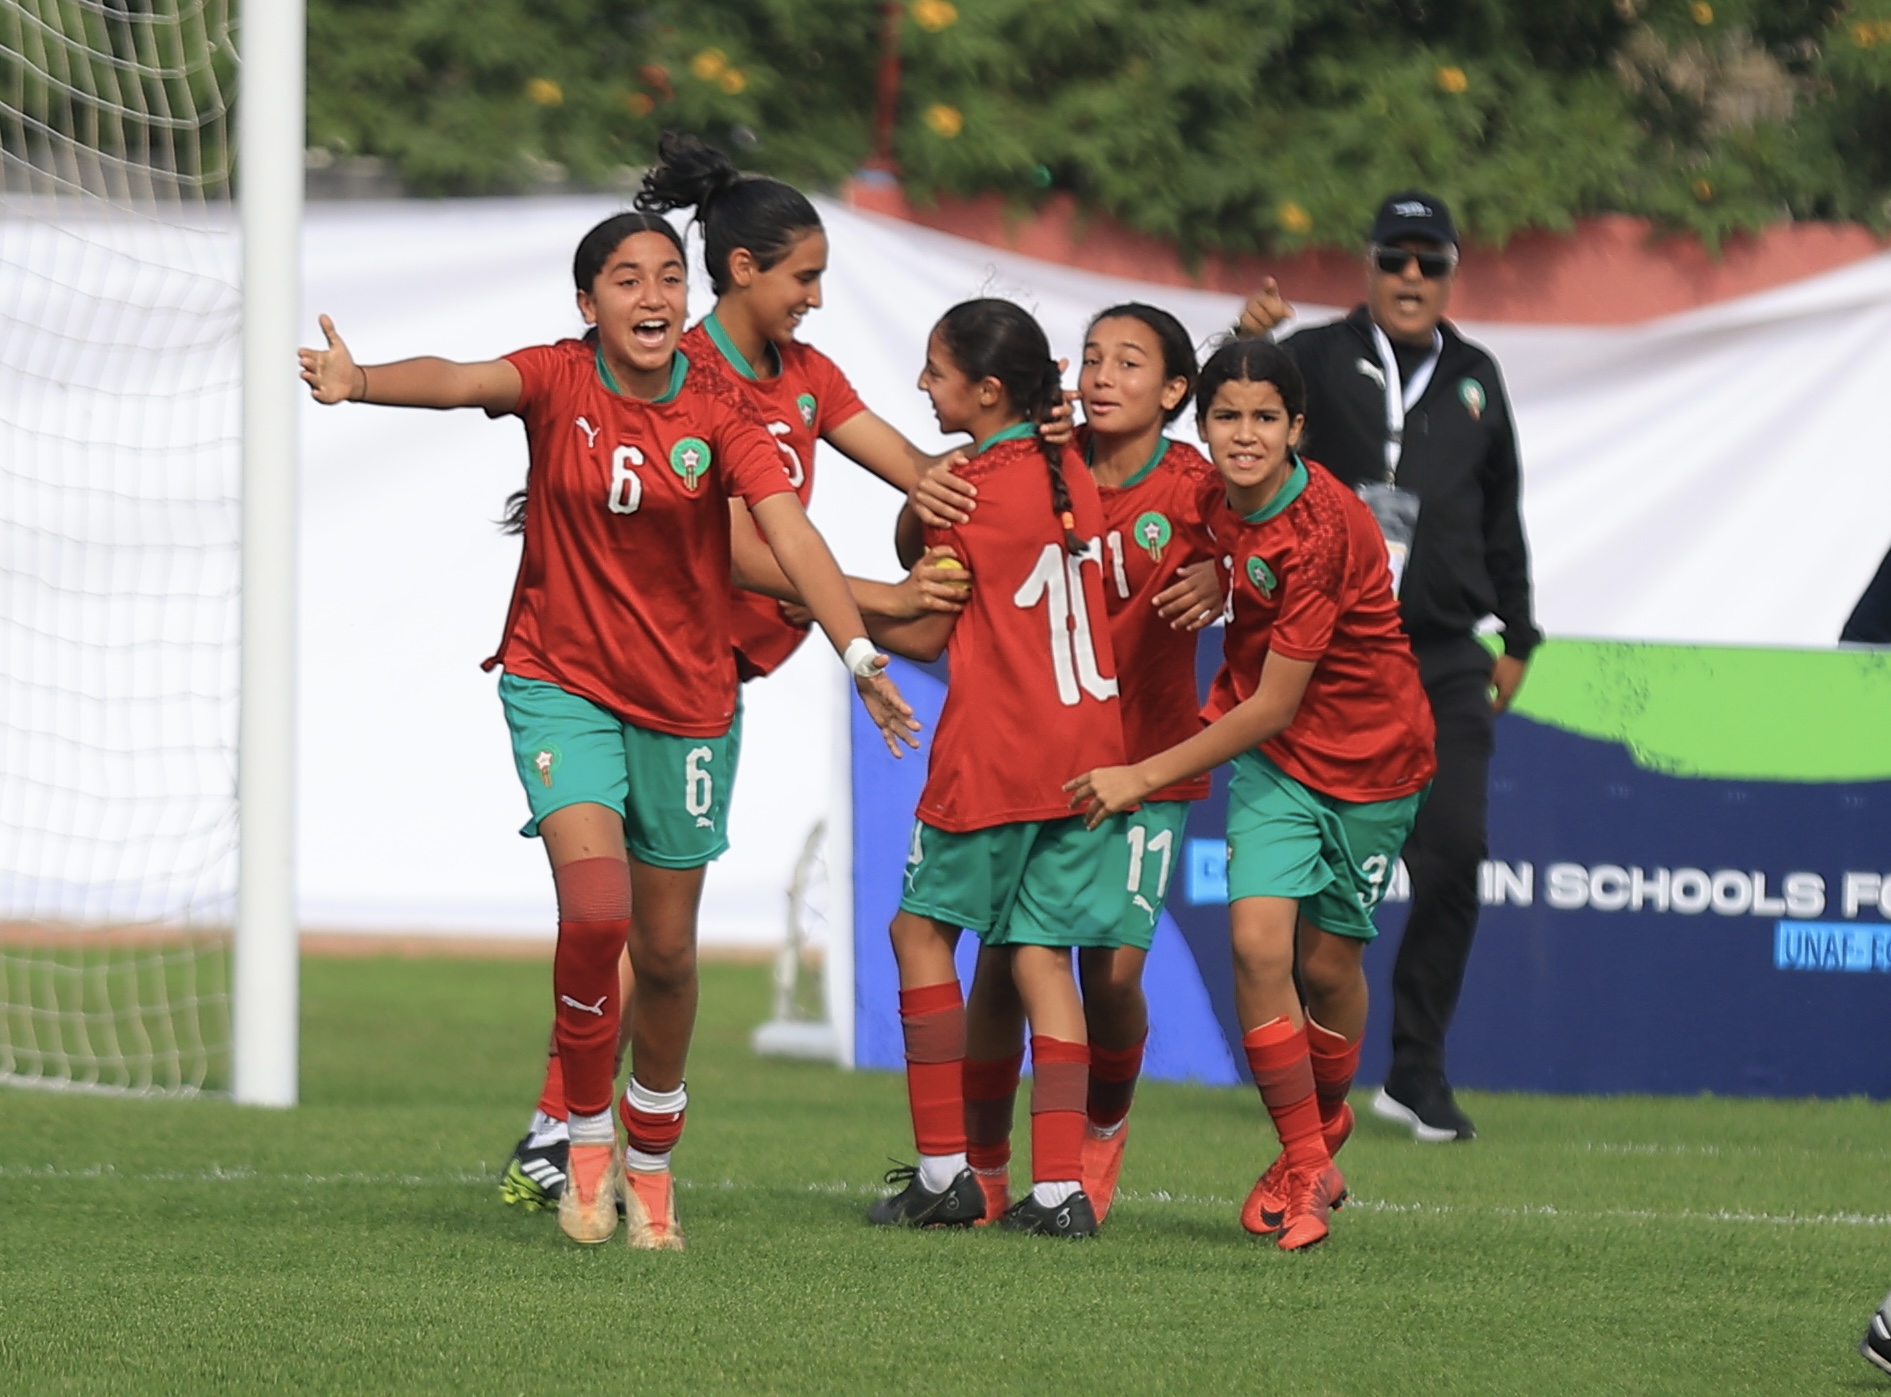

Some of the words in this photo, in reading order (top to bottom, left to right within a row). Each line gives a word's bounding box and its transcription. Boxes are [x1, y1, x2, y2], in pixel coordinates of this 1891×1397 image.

[608, 445, 645, 515] 6
[685, 746, 713, 816] 6
[1127, 825, 1173, 898] 11
[1357, 854, 1388, 908] 3
[1478, 860, 1534, 906] IN
[1546, 862, 1826, 918] SCHOOLS
